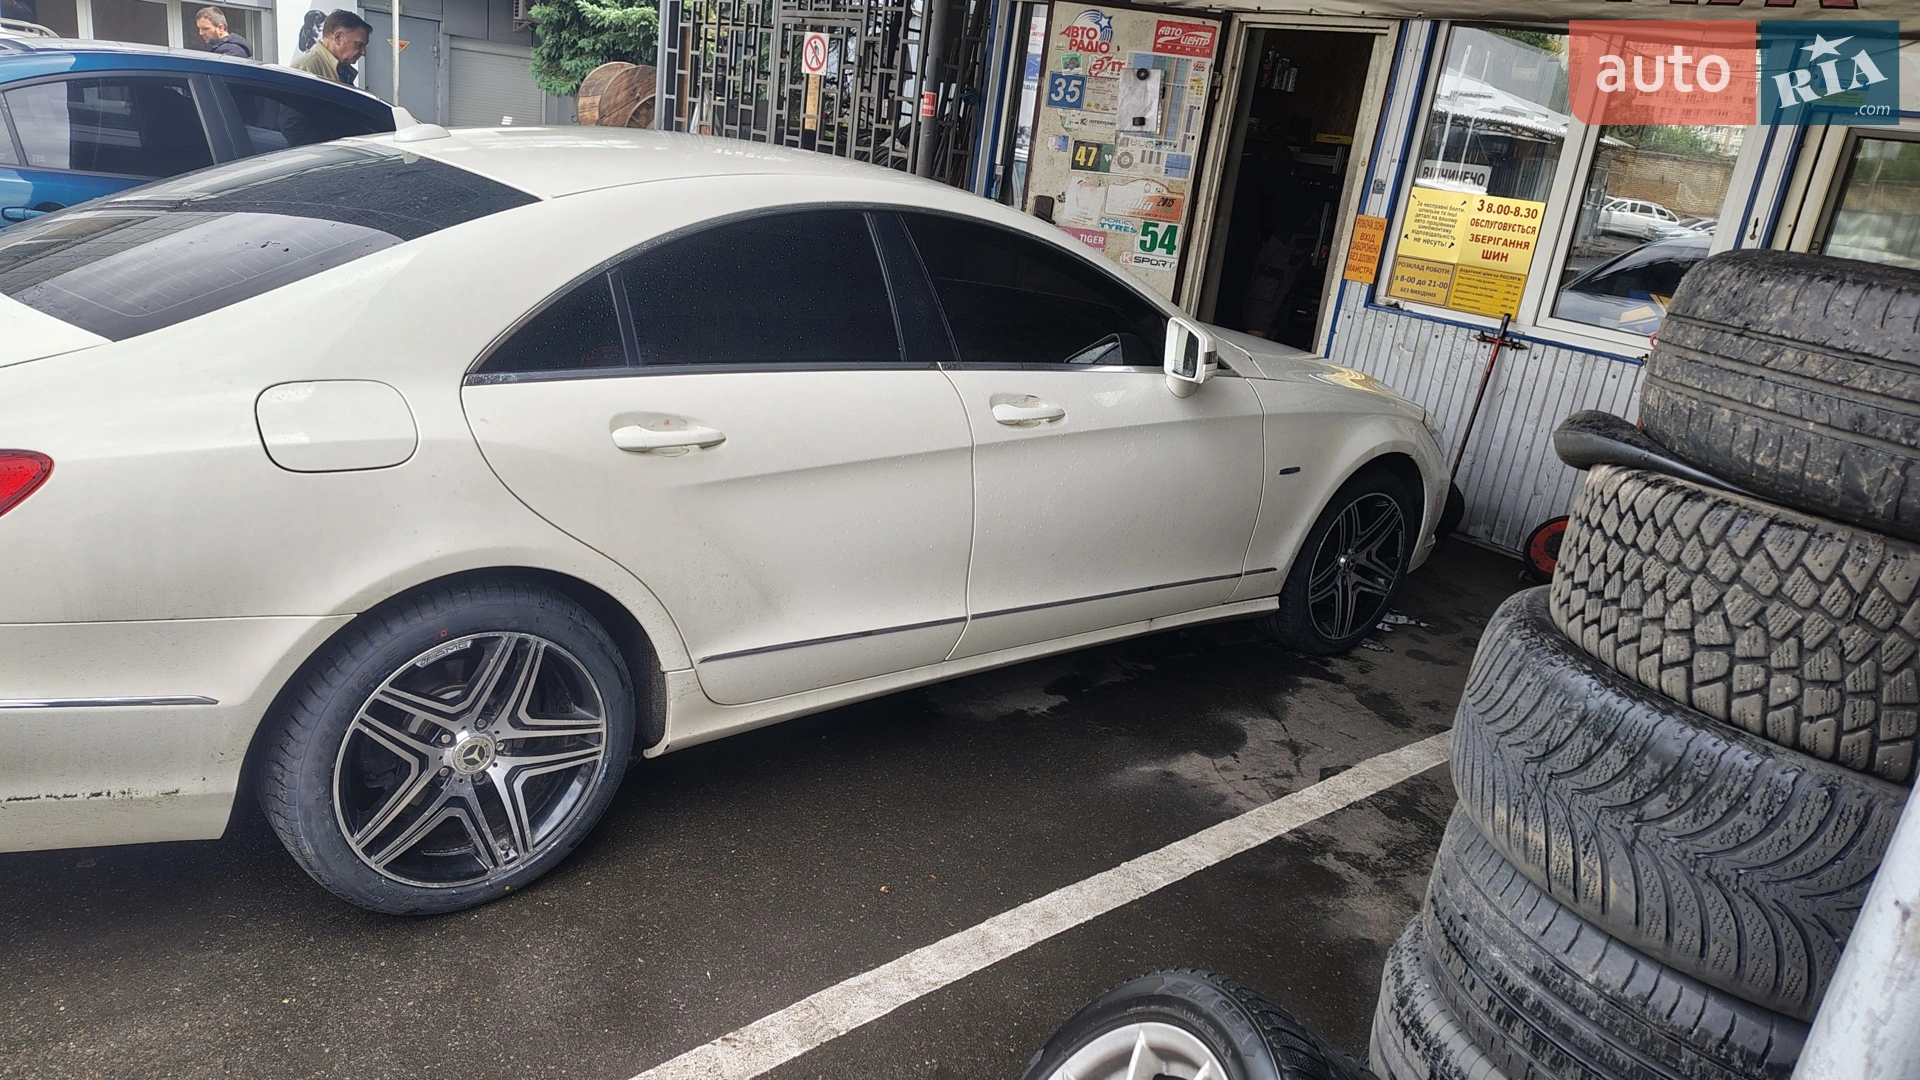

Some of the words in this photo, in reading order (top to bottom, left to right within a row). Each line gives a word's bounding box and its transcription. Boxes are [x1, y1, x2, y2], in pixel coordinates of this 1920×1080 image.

[1158, 26, 1183, 37] АВТО
[1069, 39, 1111, 54] РАДІО
[1180, 36, 1211, 47] ЦЕНТР
[1156, 44, 1210, 54] ЖУРНАЛ
[1051, 78, 1082, 103] 35
[1074, 145, 1098, 168] 47
[1157, 196, 1176, 208] 2015
[1486, 202, 1539, 220] 8.00-8.30
[1469, 217, 1537, 236] ОБСЛУГОВУЄТЬСЯ
[1079, 233, 1105, 245] TIGER
[1139, 221, 1178, 255] 54
[1360, 232, 1376, 243] ВХІД
[1468, 233, 1531, 251] ЗБЕРІГАННЯ
[1351, 240, 1379, 254] ЗАБОРОНЕНО
[1134, 255, 1176, 269] SPORT
[1481, 249, 1510, 263] ШИН
[1397, 261, 1425, 271] РОЗКЛАД
[1399, 274, 1416, 283] 8-00
[1427, 279, 1449, 289] 21-00
